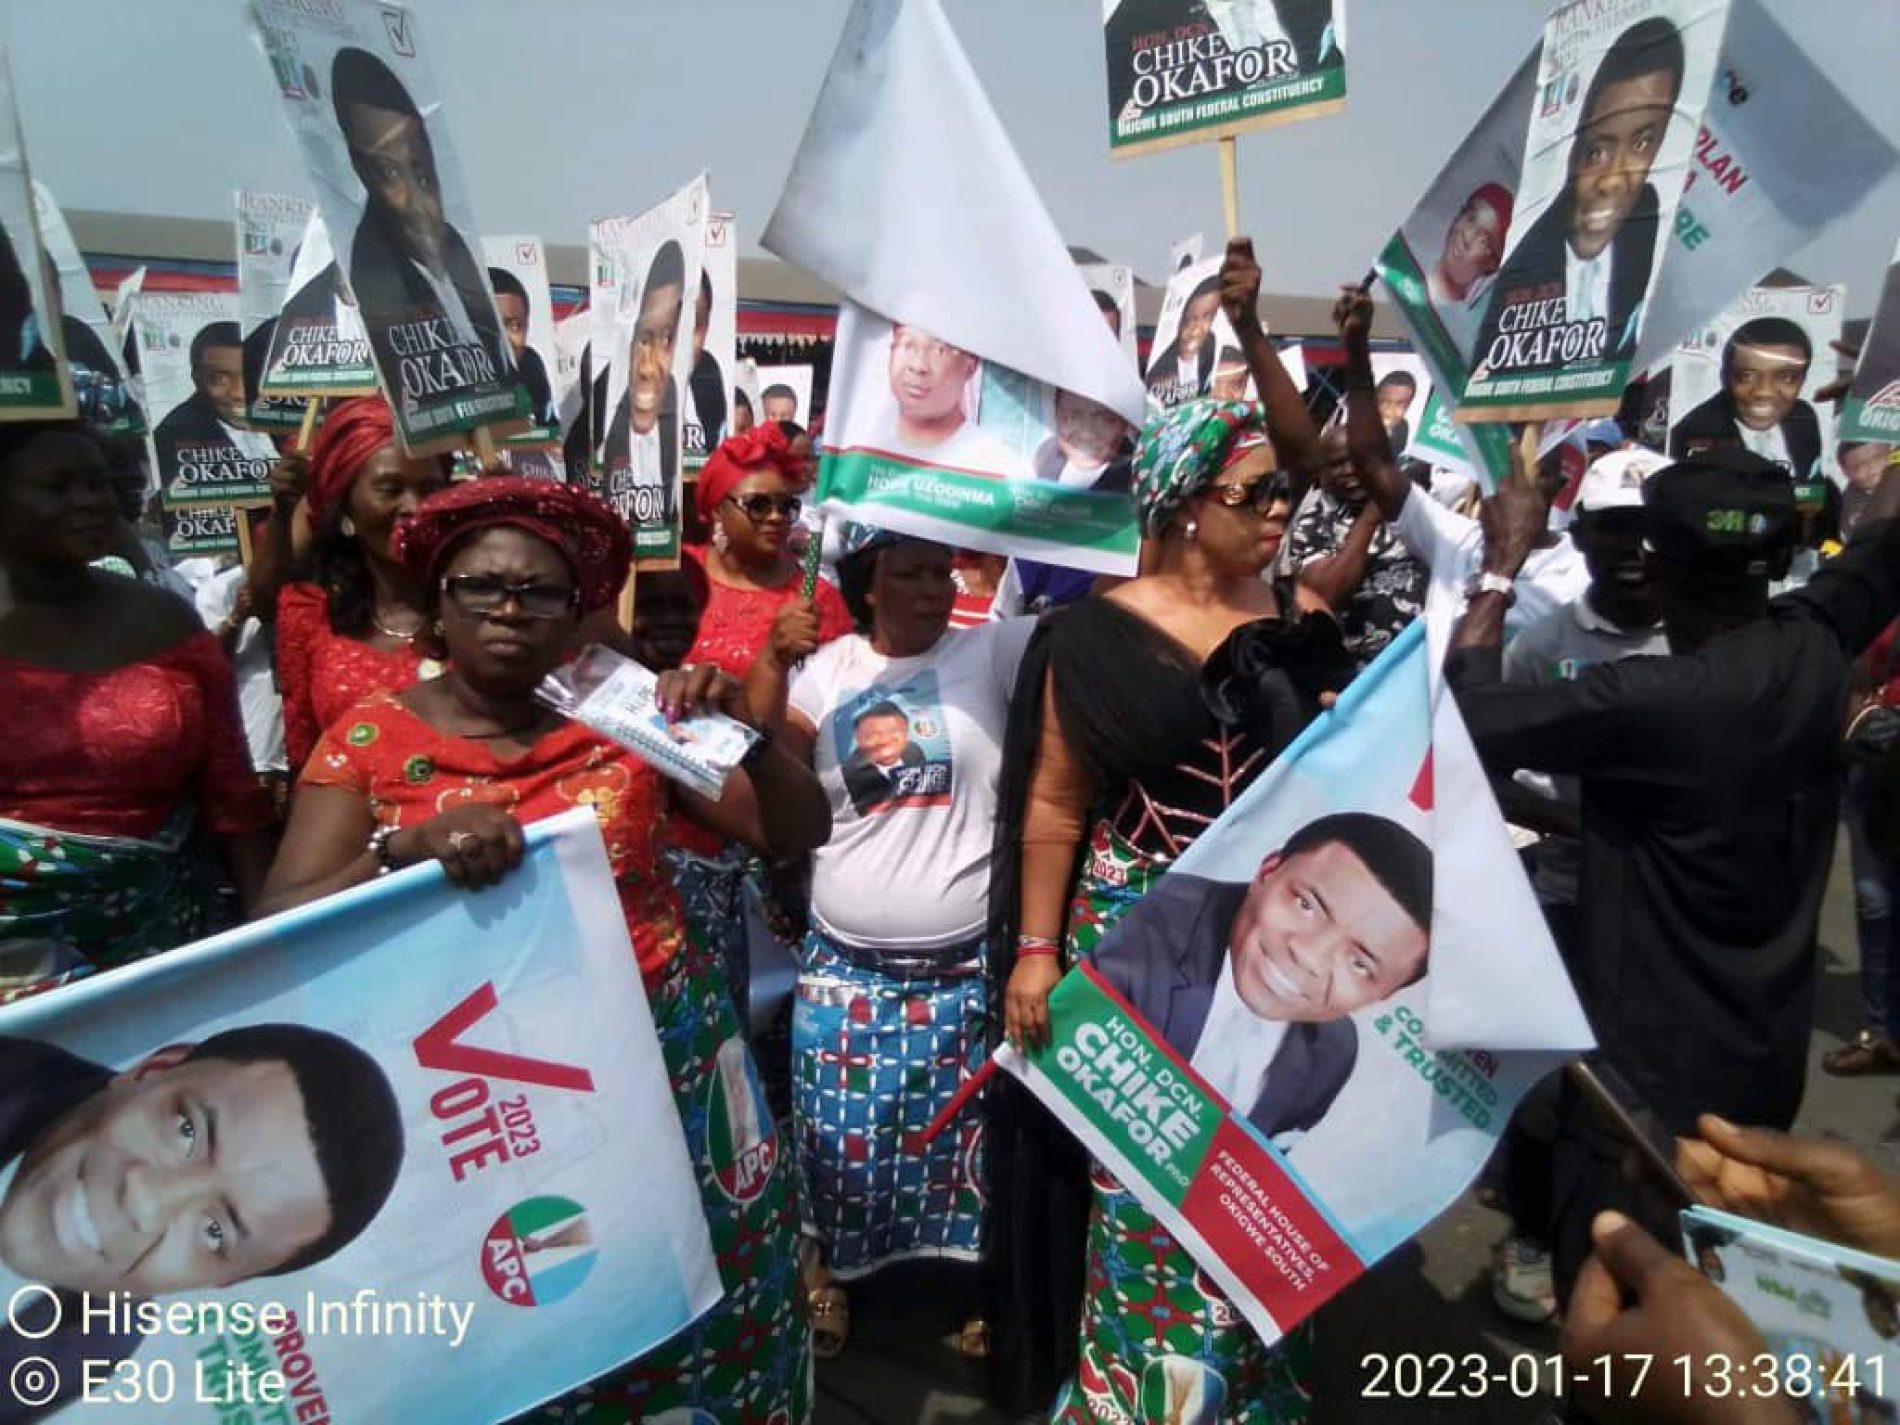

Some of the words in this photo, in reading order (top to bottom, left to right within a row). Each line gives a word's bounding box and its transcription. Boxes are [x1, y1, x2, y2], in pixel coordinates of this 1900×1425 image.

[1132, 43, 1297, 107] OKAFOR
[1133, 33, 1226, 75] CHIKE
[1196, 97, 1240, 119] FEDERAL
[1242, 77, 1325, 107] CONSTITUENCY
[288, 326, 339, 344] CHIKE
[1500, 297, 1567, 332] CHIKE
[283, 341, 367, 367] OKAFOR
[1488, 321, 1604, 369] OKAFOR
[178, 446, 242, 463] CHIKE
[179, 459, 274, 483] OKAFO
[1075, 1022, 1201, 1150] CHIKE
[1106, 1015, 1152, 1071] HON.
[1155, 1068, 1203, 1121] DCN.
[499, 1094, 541, 1158] 2023
[1056, 1046, 1172, 1166] OKAFOR
[734, 1142, 773, 1195] APC
[1217, 1149, 1270, 1207] FEDERAL
[1269, 1205, 1312, 1252] HOUSE
[1309, 1251, 1331, 1272] OF
[486, 1237, 526, 1299] APC
[1264, 1246, 1307, 1291] SOUTH
